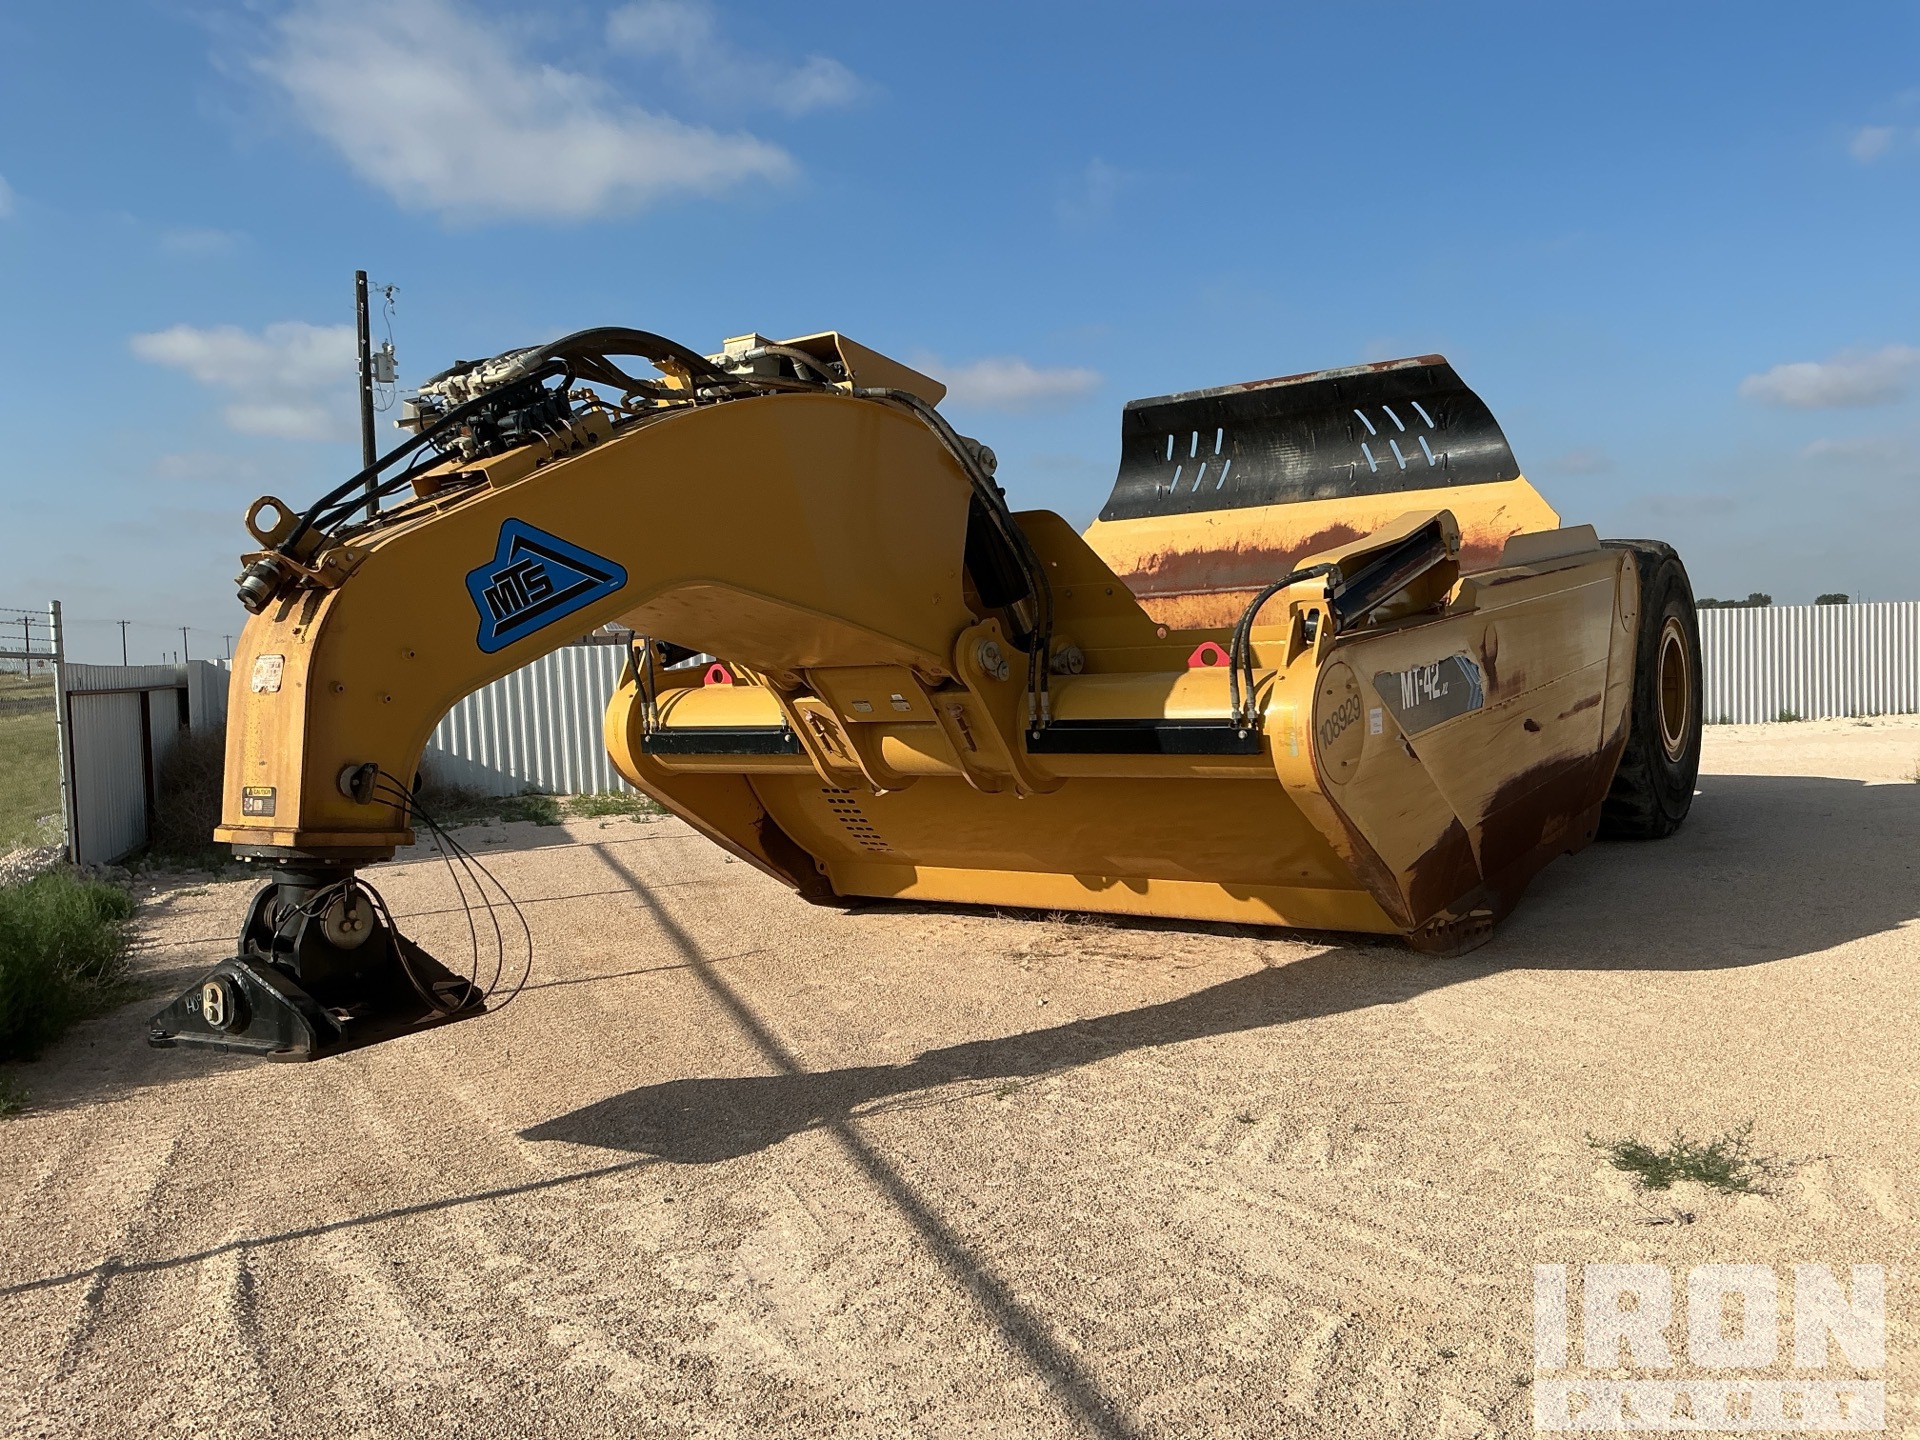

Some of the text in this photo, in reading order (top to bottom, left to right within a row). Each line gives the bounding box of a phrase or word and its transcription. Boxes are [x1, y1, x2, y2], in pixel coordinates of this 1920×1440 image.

[482, 558, 554, 620] MTS
[1401, 663, 1440, 710] MT-42
[1319, 693, 1361, 750] 108929
